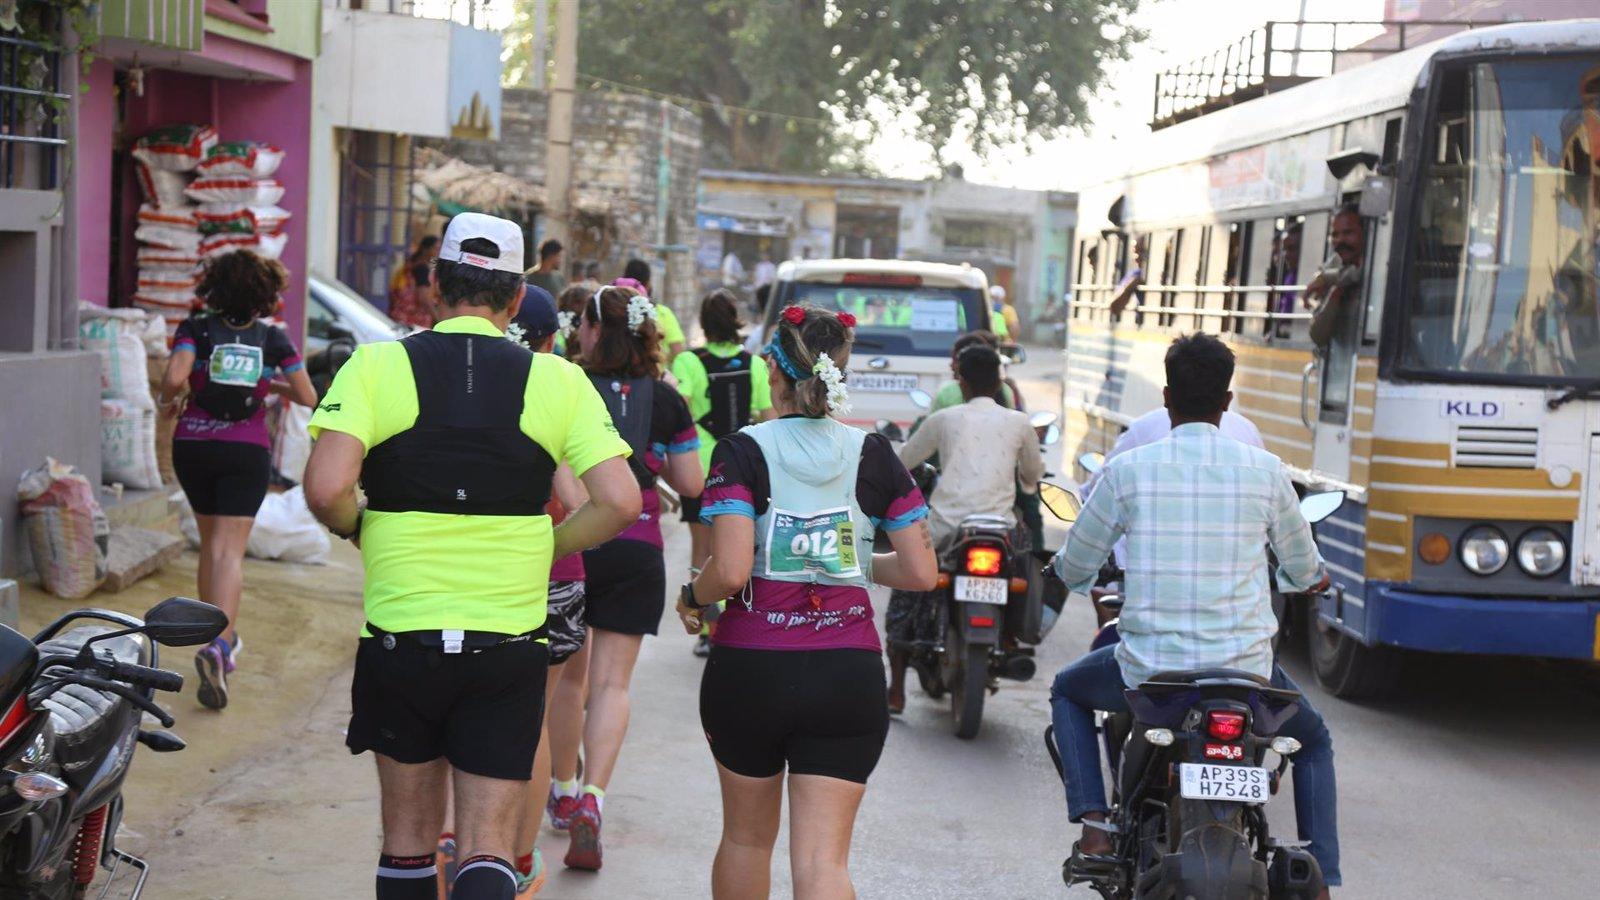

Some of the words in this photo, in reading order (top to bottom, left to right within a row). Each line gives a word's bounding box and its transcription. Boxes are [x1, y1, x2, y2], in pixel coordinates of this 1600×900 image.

[222, 354, 254, 372] 073
[1446, 401, 1498, 416] KLD
[790, 529, 839, 556] 012
[1200, 766, 1261, 784] AP39S
[1200, 781, 1262, 799] H7548
